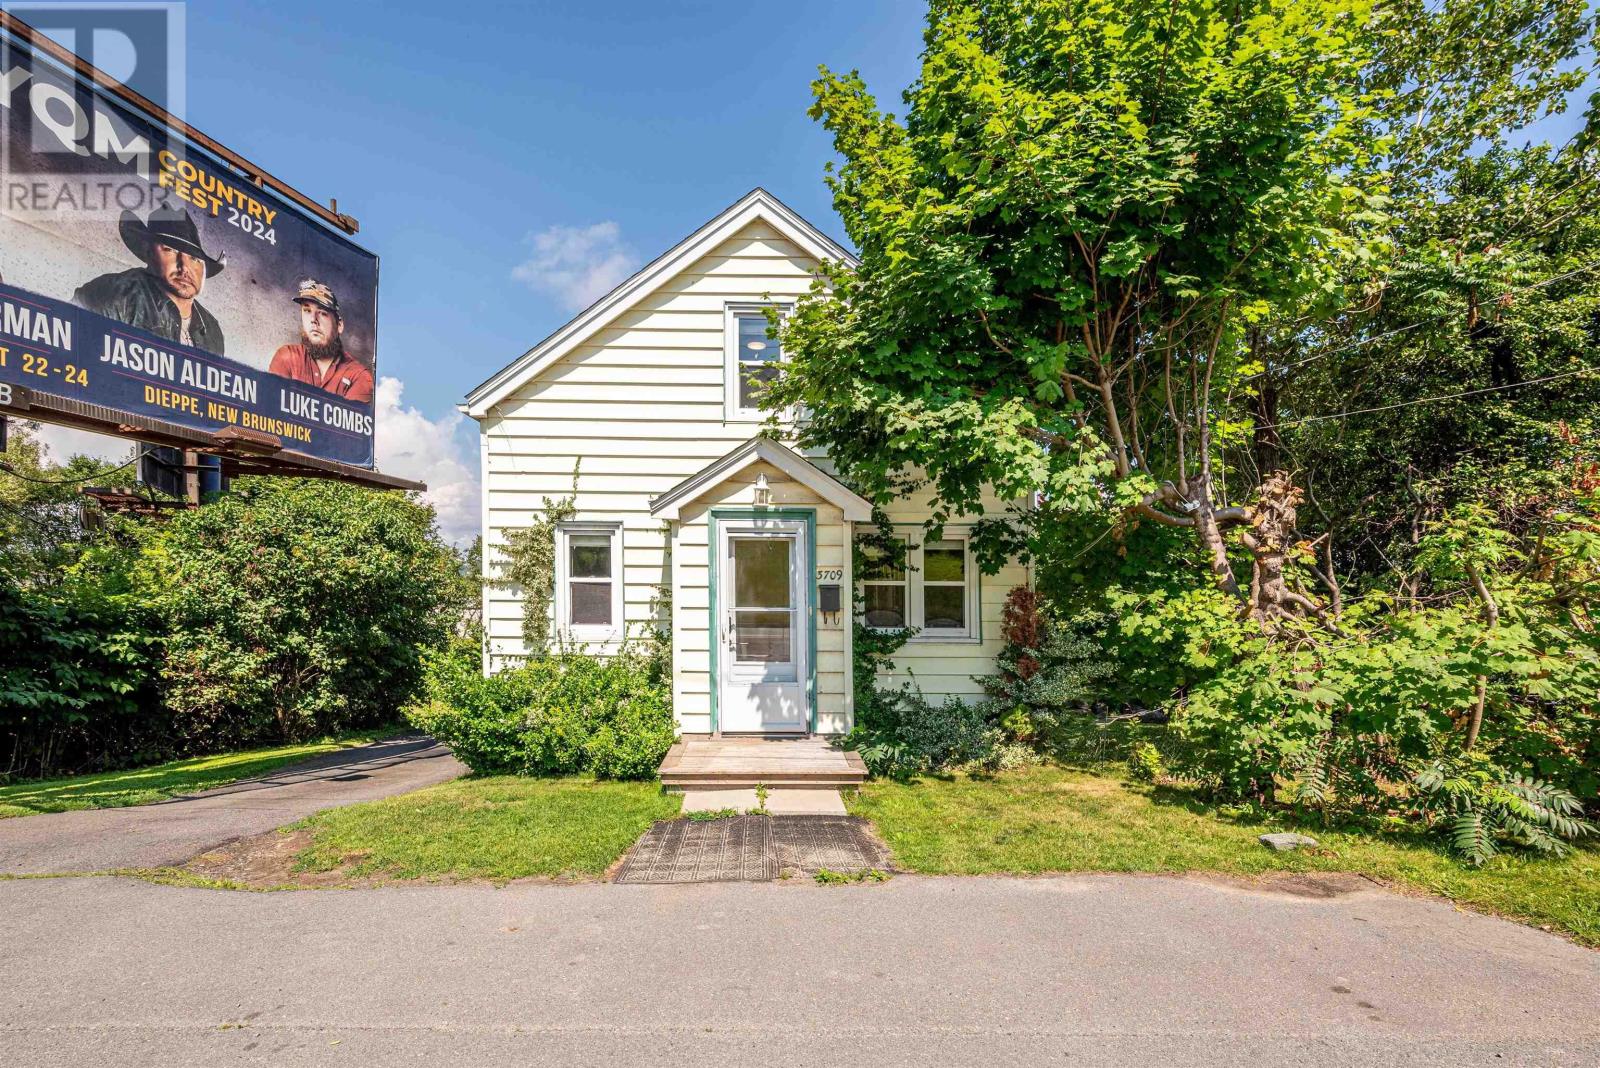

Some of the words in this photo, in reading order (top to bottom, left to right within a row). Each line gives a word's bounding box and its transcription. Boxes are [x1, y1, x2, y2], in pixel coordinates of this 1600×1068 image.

[158, 150, 277, 225] COUNTRY
[159, 169, 223, 216] FEST
[227, 206, 277, 246] 2024
[0, 302, 71, 351] MAN
[100, 334, 175, 381] JASON
[180, 359, 257, 404] ALDEAN
[144, 385, 203, 418] DIEPPE,
[208, 401, 238, 424] NEW
[242, 411, 312, 443] BRUNSWICK
[280, 388, 319, 421] LUKE
[323, 403, 373, 436] COMBS
[815, 569, 843, 580] 3709
